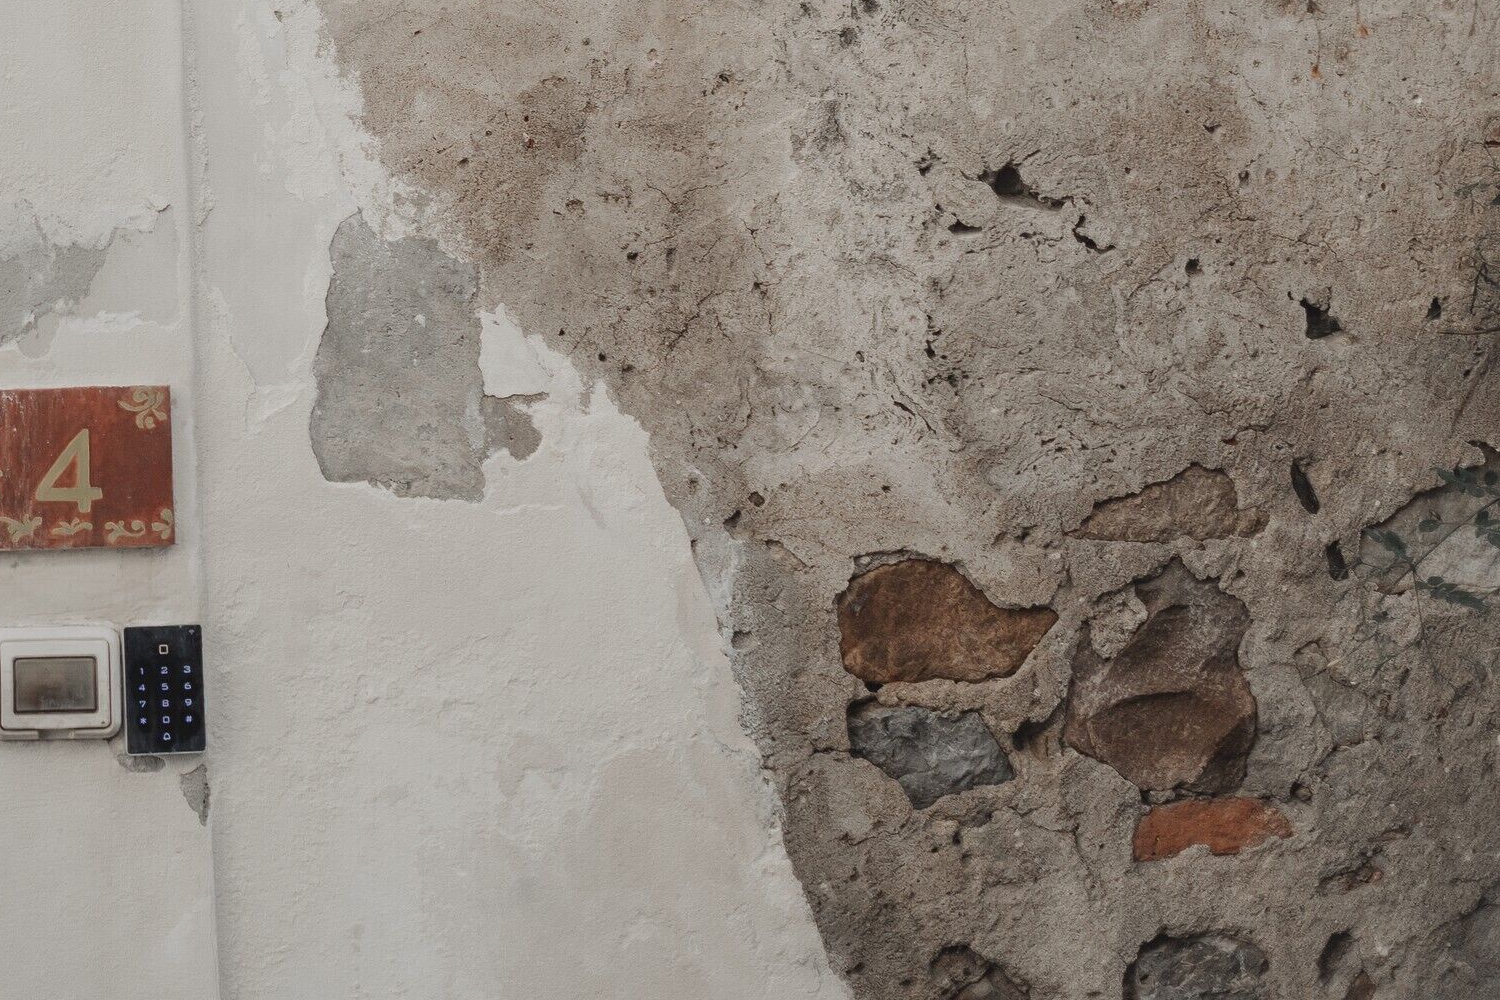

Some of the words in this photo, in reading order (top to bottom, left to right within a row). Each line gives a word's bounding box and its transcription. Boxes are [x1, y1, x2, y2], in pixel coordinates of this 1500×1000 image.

[35, 429, 103, 513] 4
[140, 667, 144, 675] 1
[161, 666, 168, 674] 2
[183, 665, 191, 674] 3
[184, 682, 192, 690] 6
[139, 700, 146, 708] 7
[162, 699, 169, 707] 8
[162, 716, 170, 724] 0
